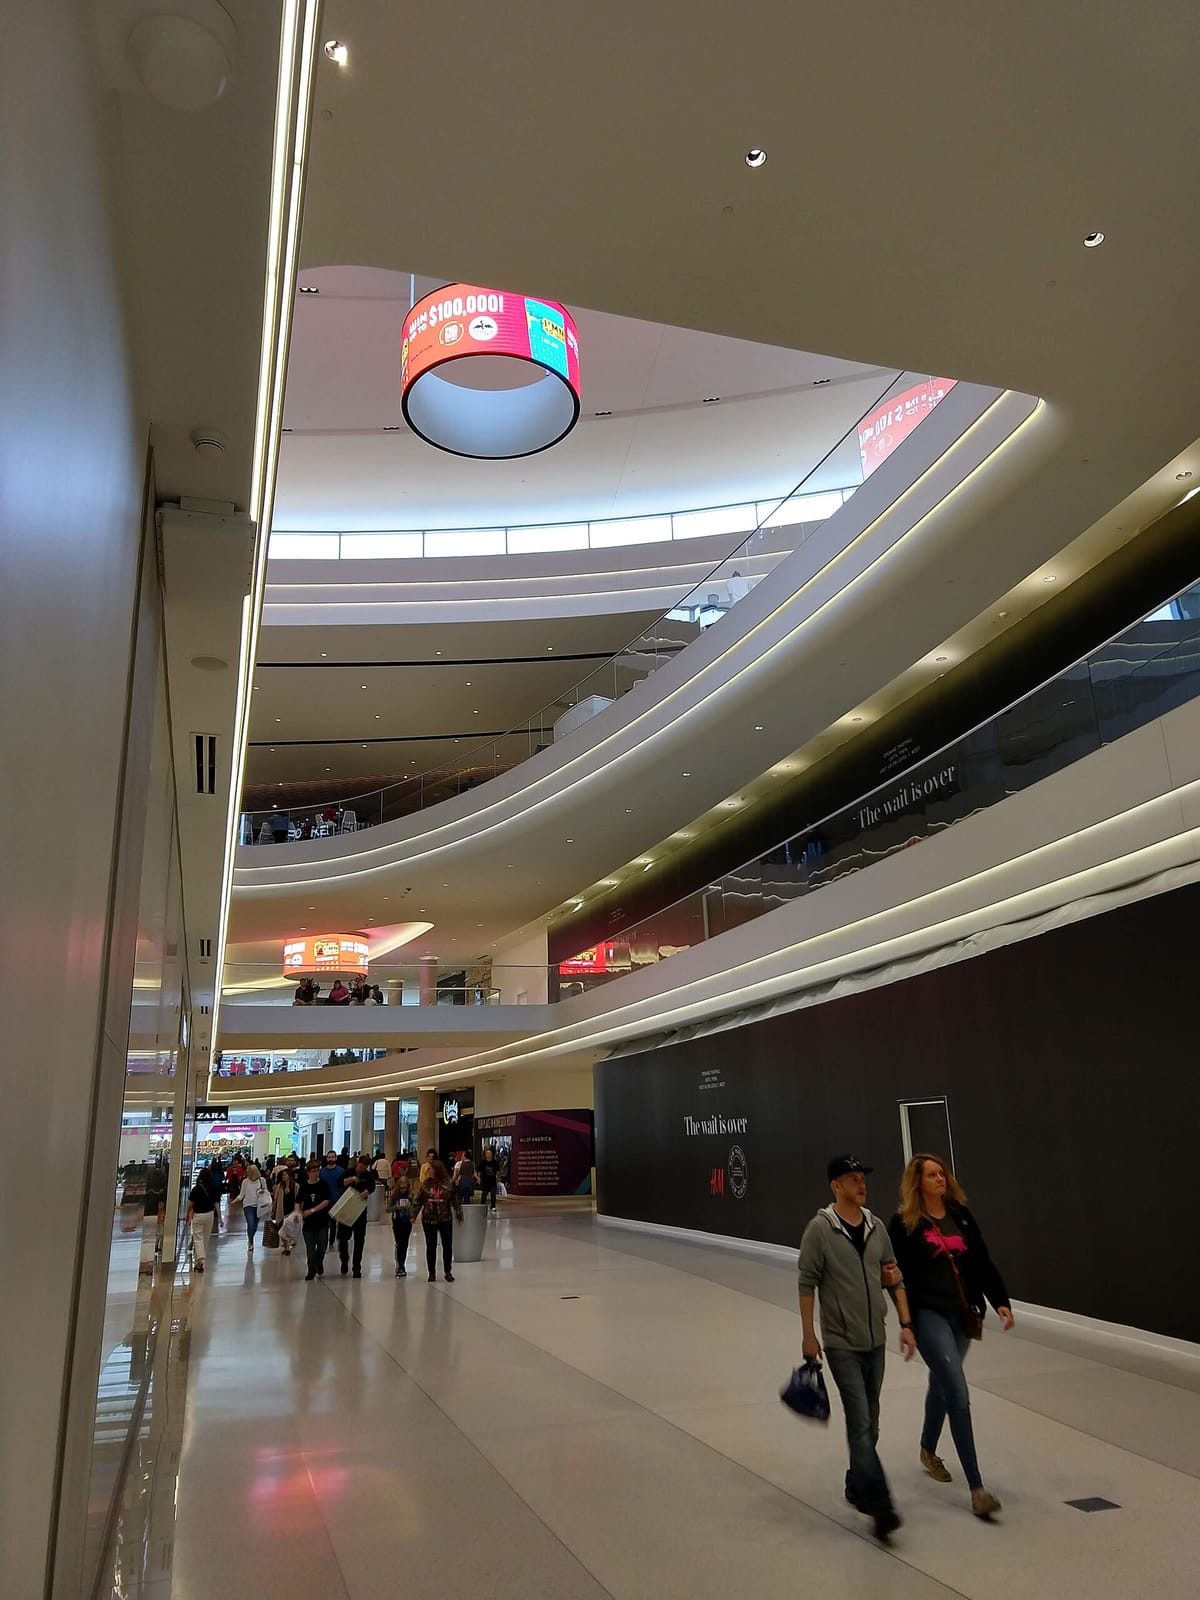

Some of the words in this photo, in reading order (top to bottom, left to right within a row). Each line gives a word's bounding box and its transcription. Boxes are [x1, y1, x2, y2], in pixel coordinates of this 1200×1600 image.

[429, 294, 504, 328] $100,000!
[859, 806, 881, 829] The
[883, 788, 909, 816] wait
[910, 782, 922, 802] is
[923, 766, 955, 794] over
[684, 1115, 700, 1136] The
[700, 1114, 719, 1136] wait
[719, 1114, 727, 1134] is
[728, 1117, 748, 1135] over
